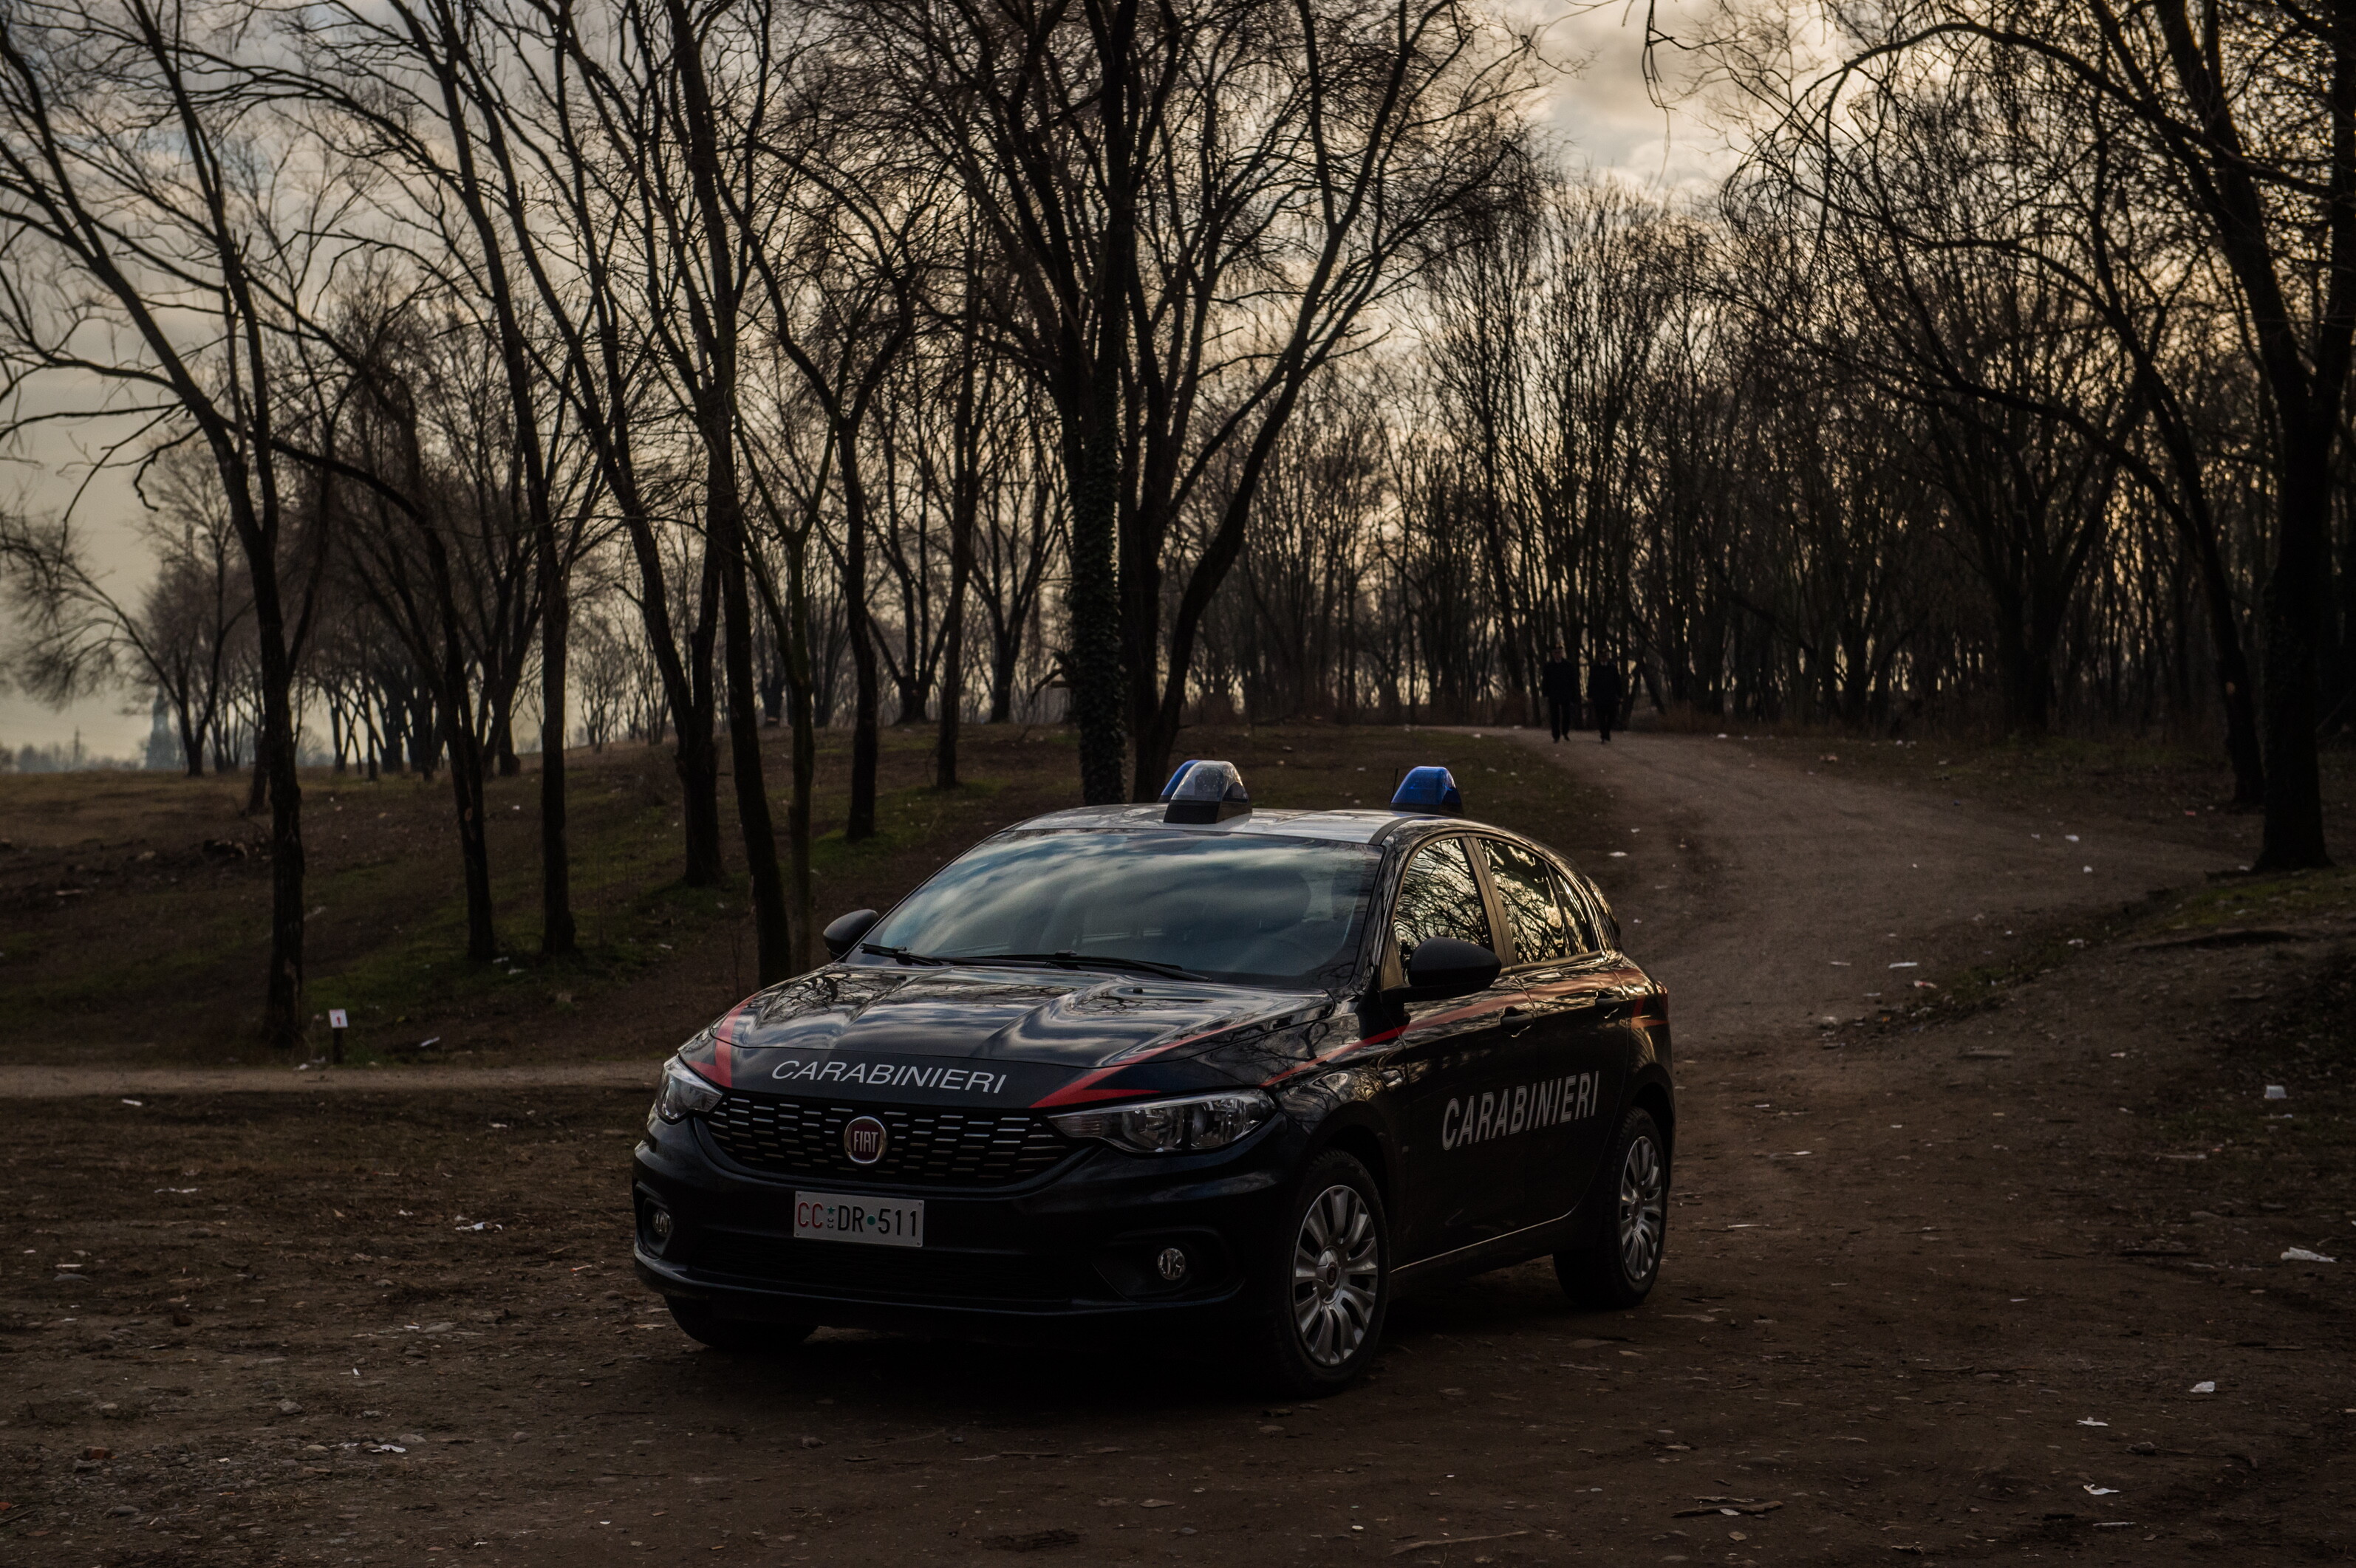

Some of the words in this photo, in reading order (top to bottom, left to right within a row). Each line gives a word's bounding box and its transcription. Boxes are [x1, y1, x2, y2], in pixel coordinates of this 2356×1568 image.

[772, 1060, 1007, 1094] CARABINIERI
[1442, 1070, 1599, 1151] CARABINIERI
[853, 1130, 878, 1153] FIAT
[798, 1202, 823, 1228] CC
[838, 1205, 864, 1233] DR
[878, 1208, 917, 1236] 511
